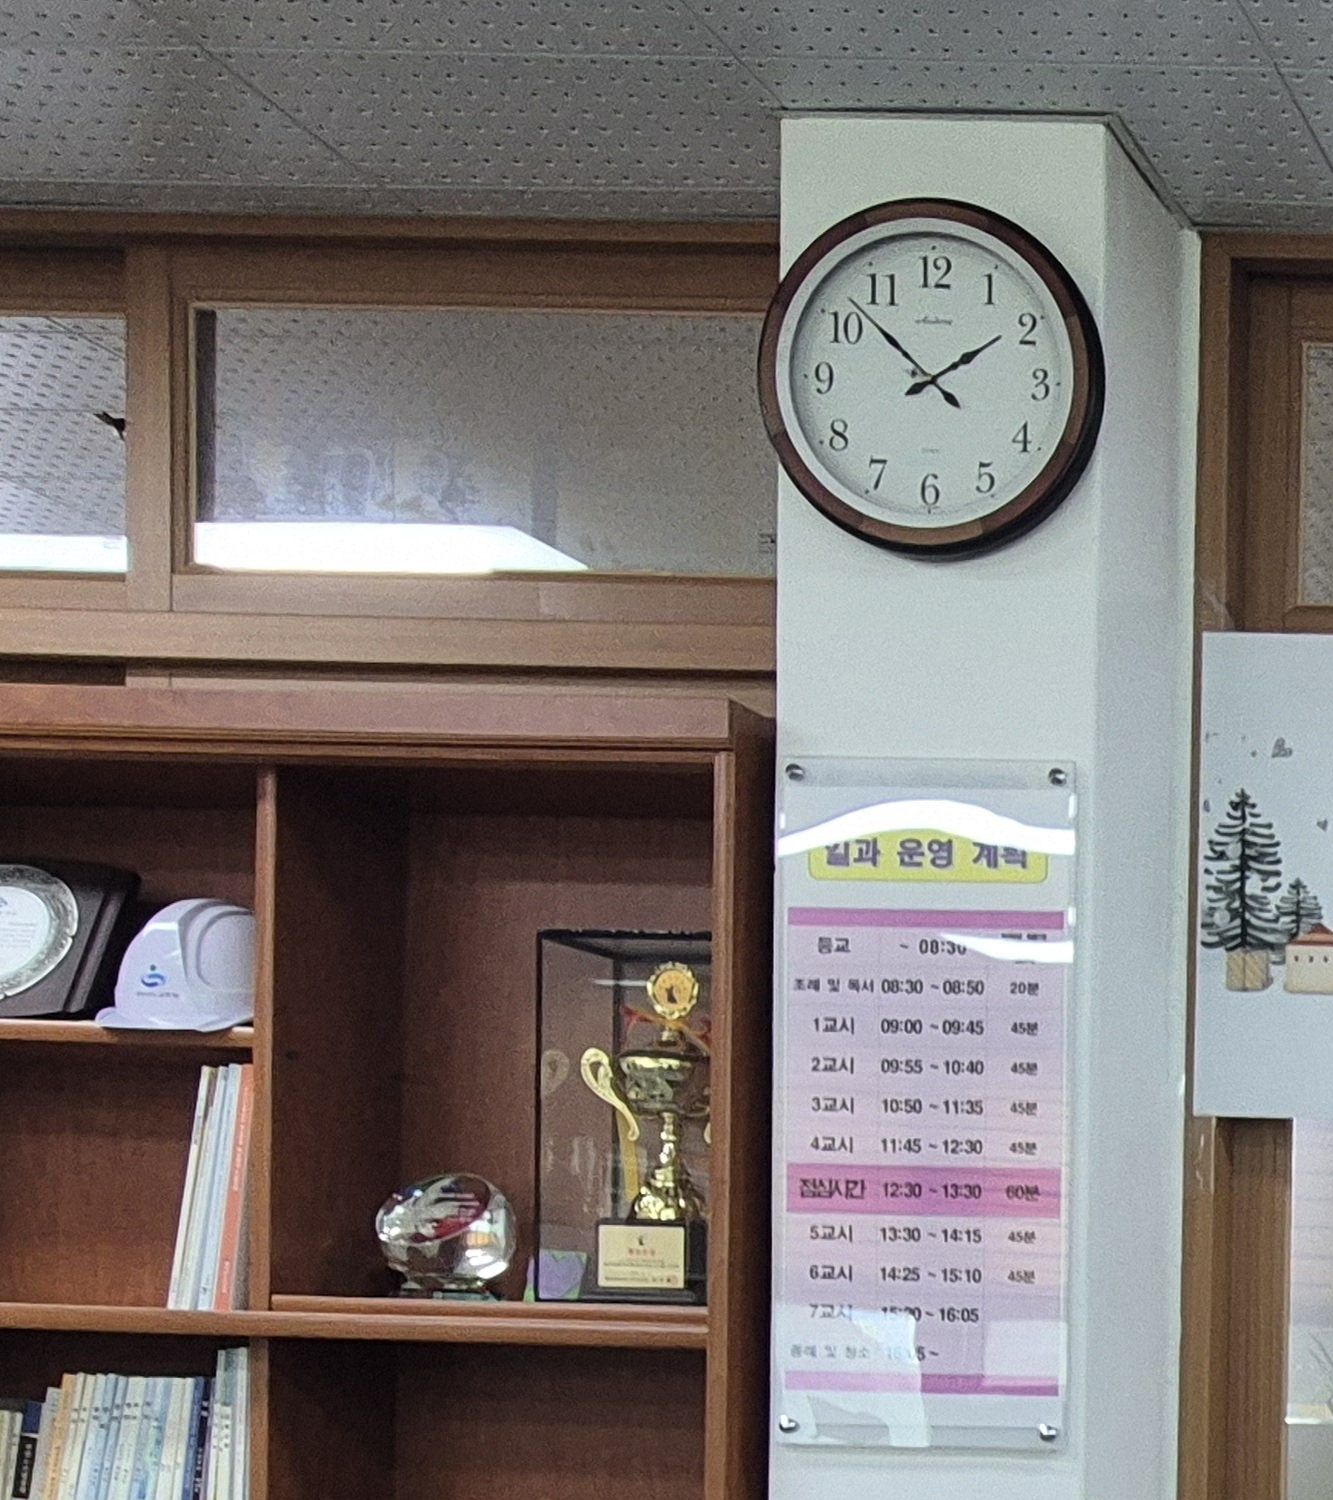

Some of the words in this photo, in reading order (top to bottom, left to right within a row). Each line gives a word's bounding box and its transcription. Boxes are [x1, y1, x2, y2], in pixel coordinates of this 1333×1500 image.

[920, 256, 952, 289] 12
[866, 273, 898, 306] 11
[984, 273, 995, 305] 1
[829, 311, 863, 344] 10
[1018, 313, 1037, 346] 2
[815, 362, 834, 394] 9
[1031, 369, 1050, 401] 3
[829, 419, 849, 451] 8
[1012, 421, 1031, 453] 4
[868, 455, 888, 490] 7
[975, 462, 995, 493] 5
[920, 473, 940, 505] 6
[897, 838, 954, 869] 운영
[817, 937, 851, 954] 등교
[794, 978, 820, 992] 조례
[827, 980, 840, 992] 및
[848, 979, 875, 993] 독서
[881, 979, 923, 995] 08:30
[943, 979, 984, 996] 08:50
[1010, 982, 1040, 997] 20분
[813, 1017, 854, 1034] 1교시
[881, 1018, 923, 1035] 09:00
[942, 1019, 984, 1035] 09:45
[1011, 1022, 1038, 1036] 45분
[811, 1057, 854, 1074] 2교시
[881, 1060, 923, 1074] 09:55
[943, 1060, 984, 1075] 10:40
[1011, 1062, 1038, 1076] 45분
[812, 1097, 854, 1114] 3교시
[883, 1099, 922, 1114] 10:50
[943, 1099, 983, 1115] 11:35
[1010, 1102, 1038, 1116] 45분
[810, 1136, 853, 1153] 4교시
[881, 1138, 922, 1154] 11:45
[942, 1139, 983, 1155] 12:30
[1009, 1142, 1037, 1155] 45분
[800, 1179, 866, 1200] 점심시간
[883, 1182, 922, 1198] 12:30
[942, 1182, 982, 1199] 13:30
[1005, 1186, 1040, 1201] 60분
[810, 1226, 853, 1243] 5교시
[880, 1227, 921, 1242] 13:30
[941, 1228, 982, 1243] 14:15
[1008, 1230, 1036, 1244] 45분
[809, 1265, 853, 1282] 6교시
[880, 1266, 921, 1282] 14:25
[941, 1267, 982, 1283] 15:10
[1008, 1270, 1035, 1284] 45분
[809, 1303, 852, 1320] 7교시
[939, 1307, 979, 1323] 16:05
